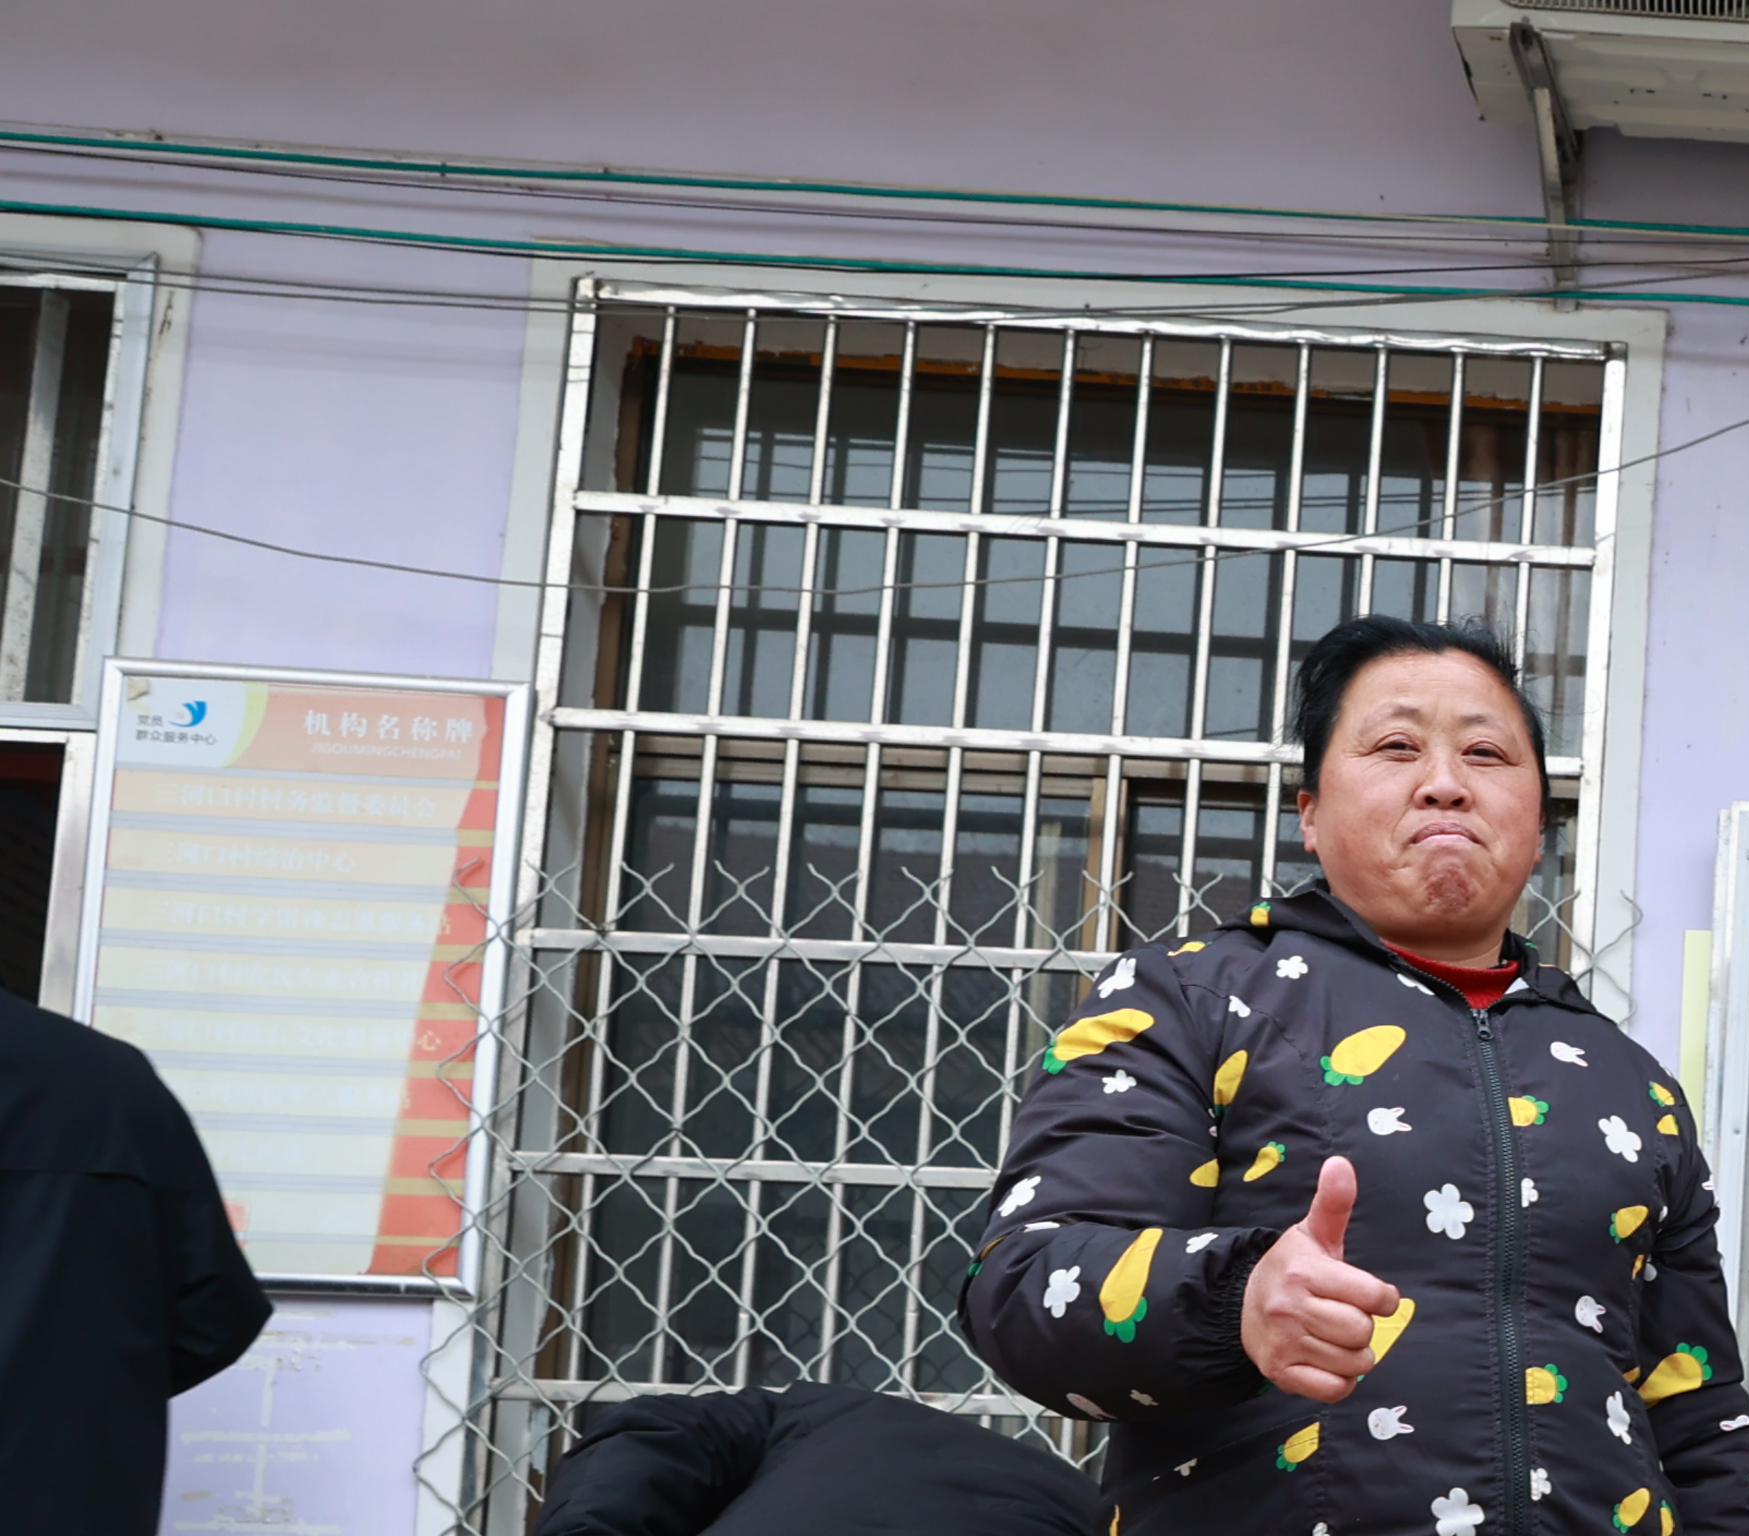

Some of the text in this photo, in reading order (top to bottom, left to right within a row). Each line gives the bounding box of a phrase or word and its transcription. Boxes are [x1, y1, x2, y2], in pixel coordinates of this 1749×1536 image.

[135, 729, 217, 746] 群众服务中心
[304, 709, 474, 743] 机构名称牌
